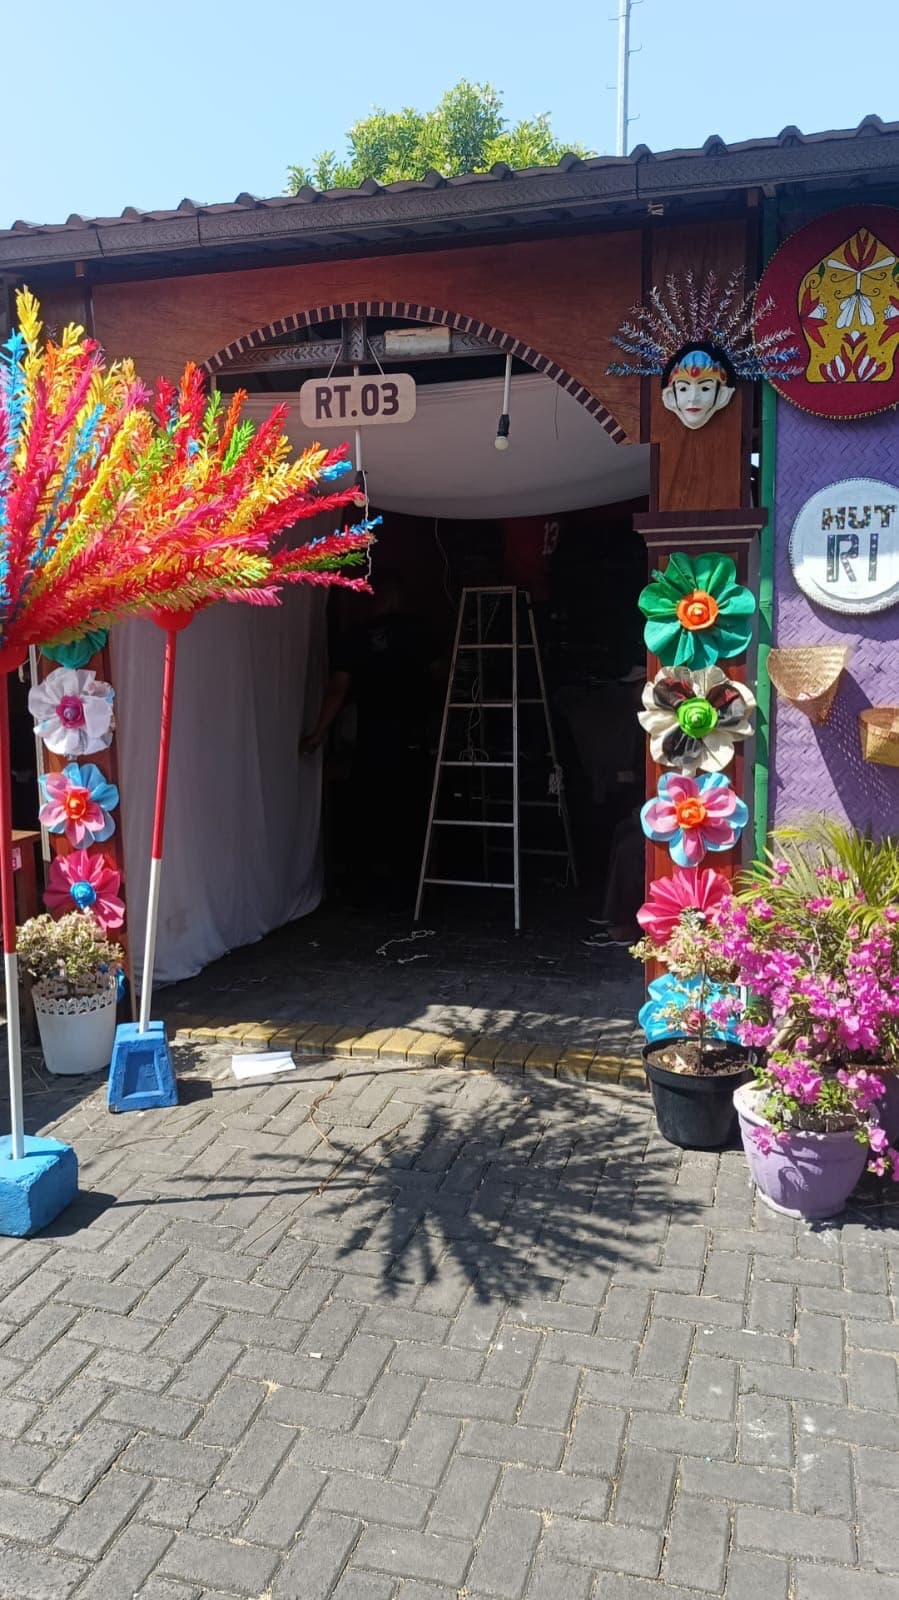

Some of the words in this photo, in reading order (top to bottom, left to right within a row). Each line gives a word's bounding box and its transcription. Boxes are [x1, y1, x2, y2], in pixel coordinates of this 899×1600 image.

[315, 382, 399, 419] RT.03
[821, 504, 897, 530] HUT
[826, 533, 879, 582] RI
